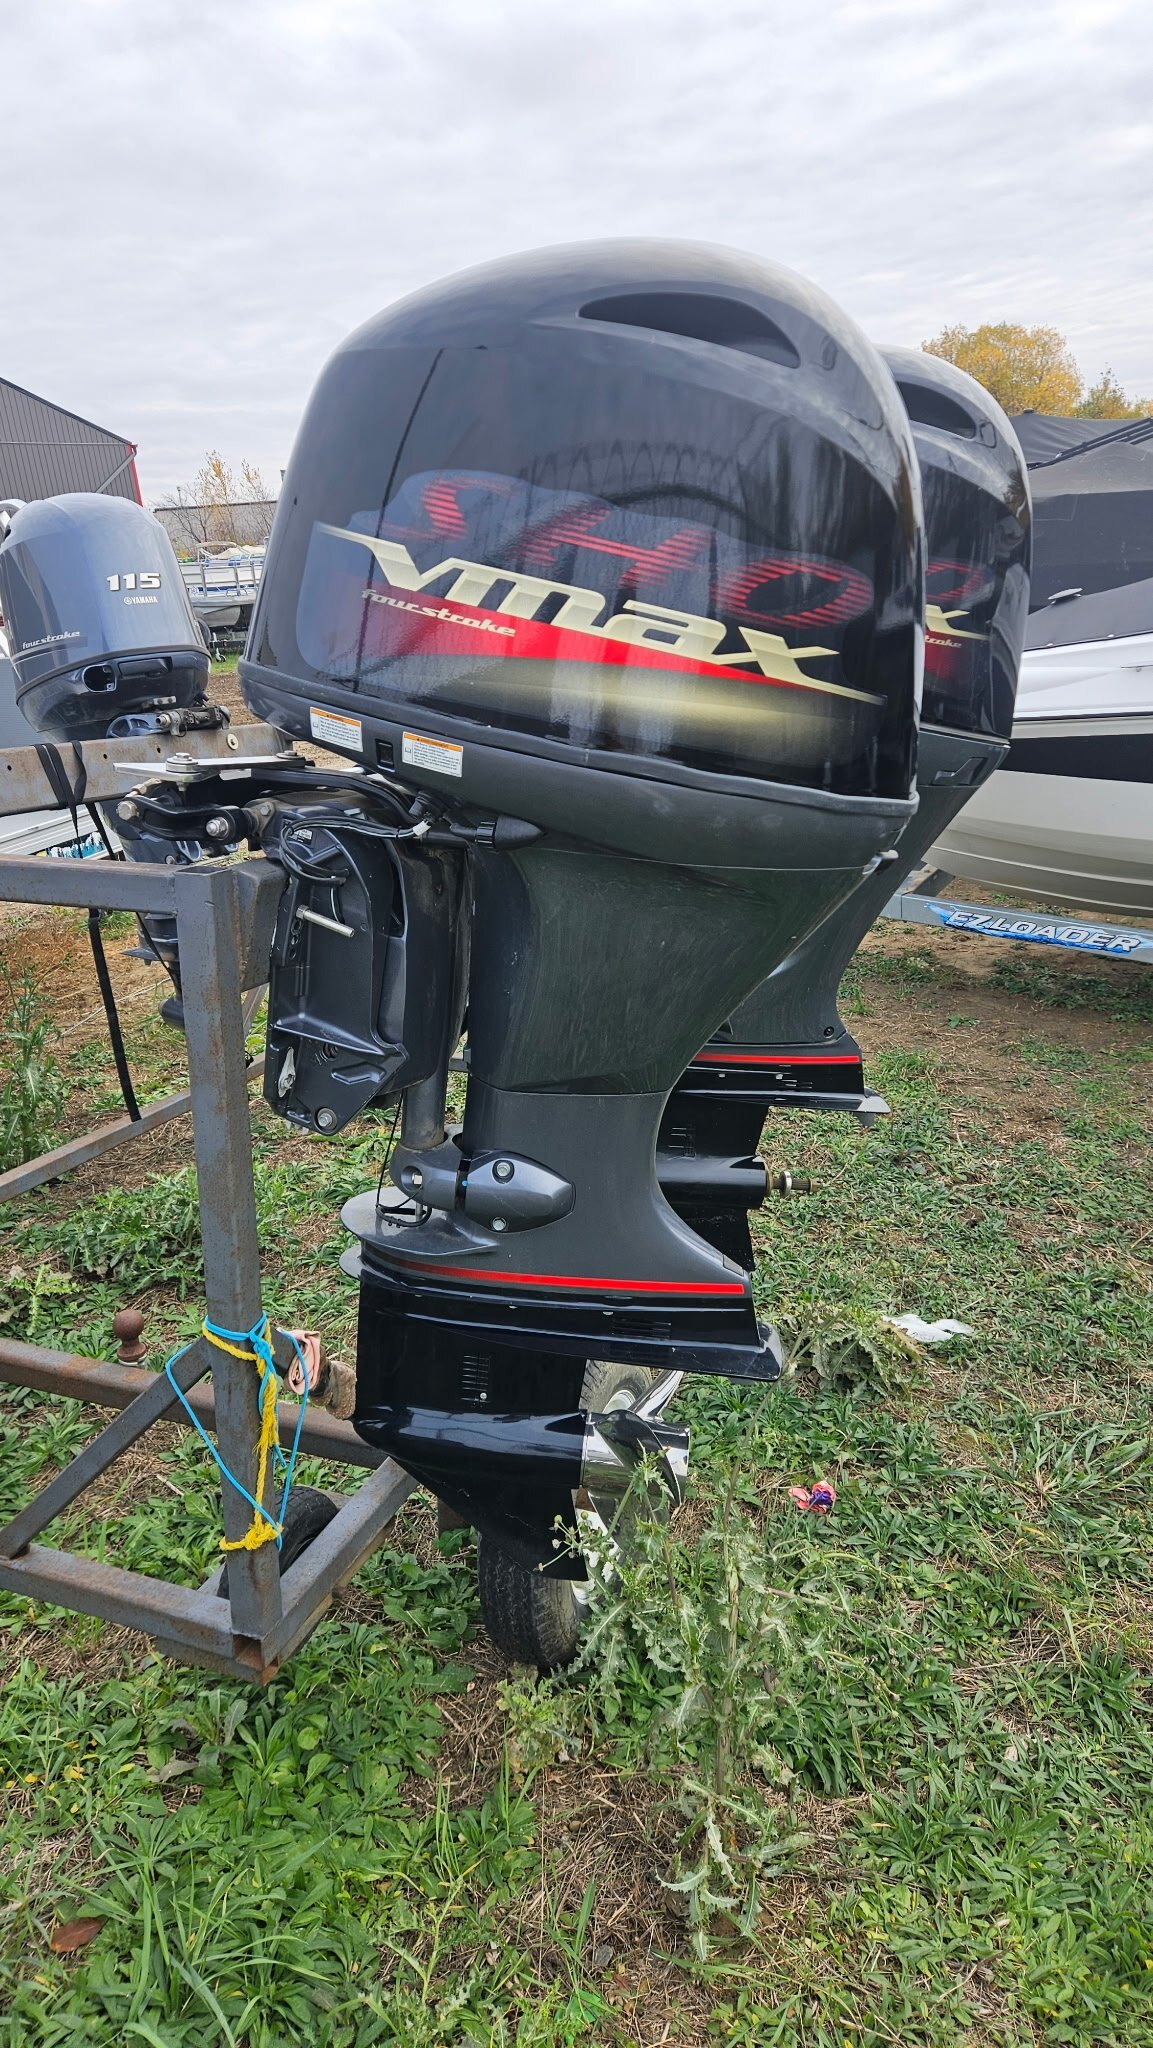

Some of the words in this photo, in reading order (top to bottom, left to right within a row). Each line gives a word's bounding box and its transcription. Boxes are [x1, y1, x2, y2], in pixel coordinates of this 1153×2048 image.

[376, 476, 874, 629] SHO
[106, 572, 161, 592] 115
[131, 595, 158, 605] YAMAHA
